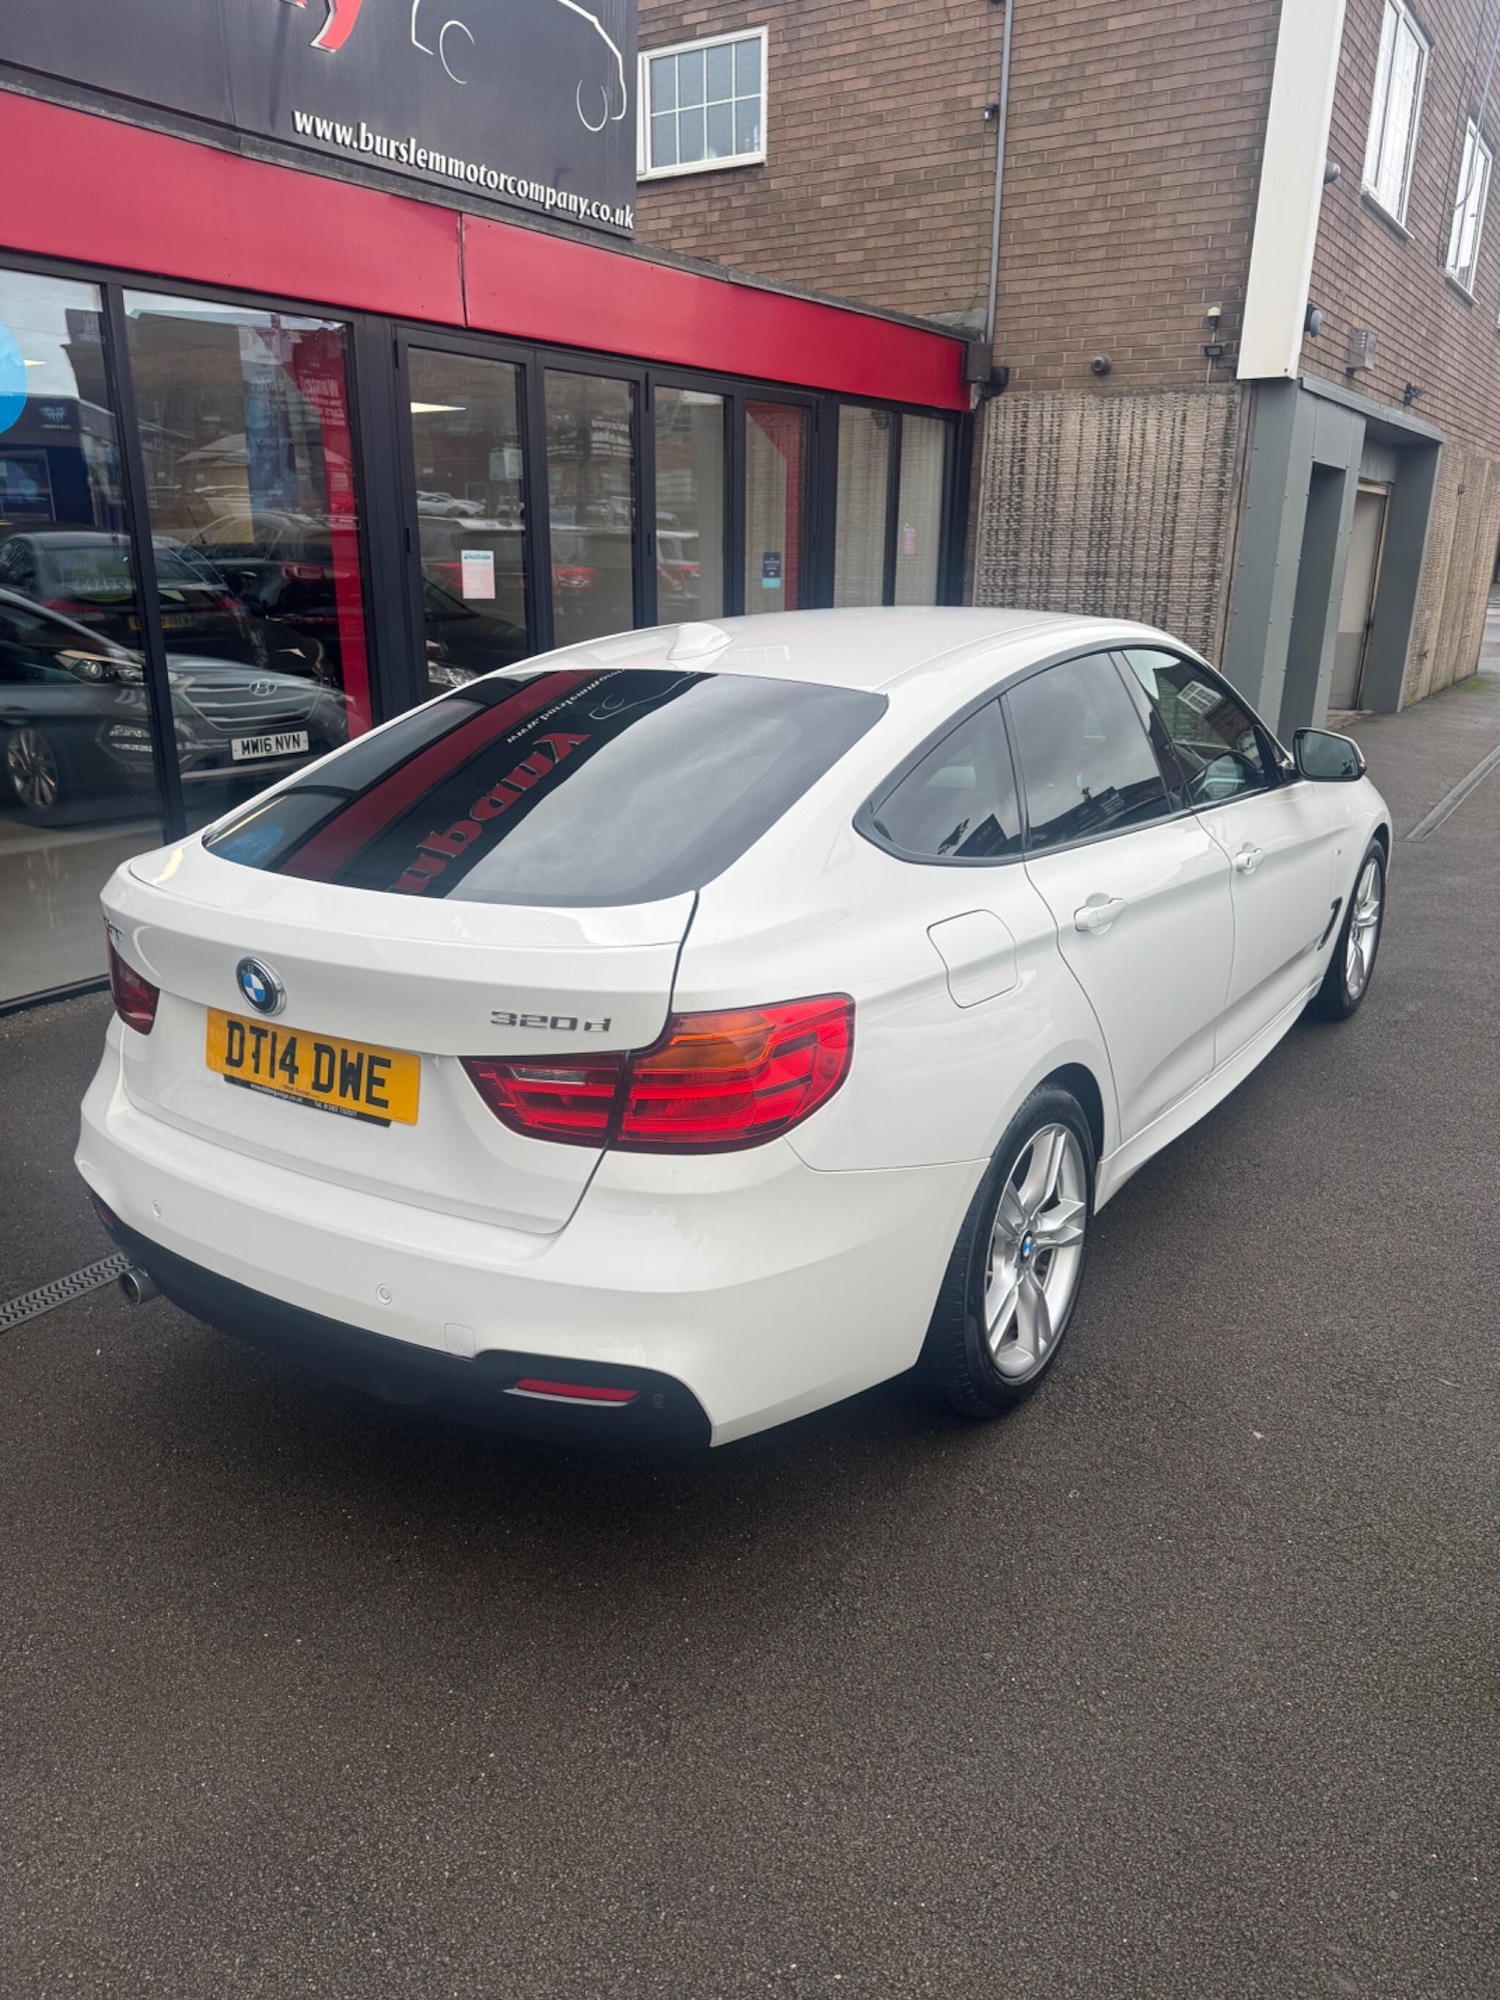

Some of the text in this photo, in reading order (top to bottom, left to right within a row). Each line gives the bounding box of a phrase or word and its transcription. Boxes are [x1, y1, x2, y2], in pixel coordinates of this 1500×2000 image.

[291, 109, 635, 231] www.burslemmotorcompany.co.uk
[241, 733, 301, 756] MW16 NVN
[225, 1020, 392, 1110] DT14 DWE
